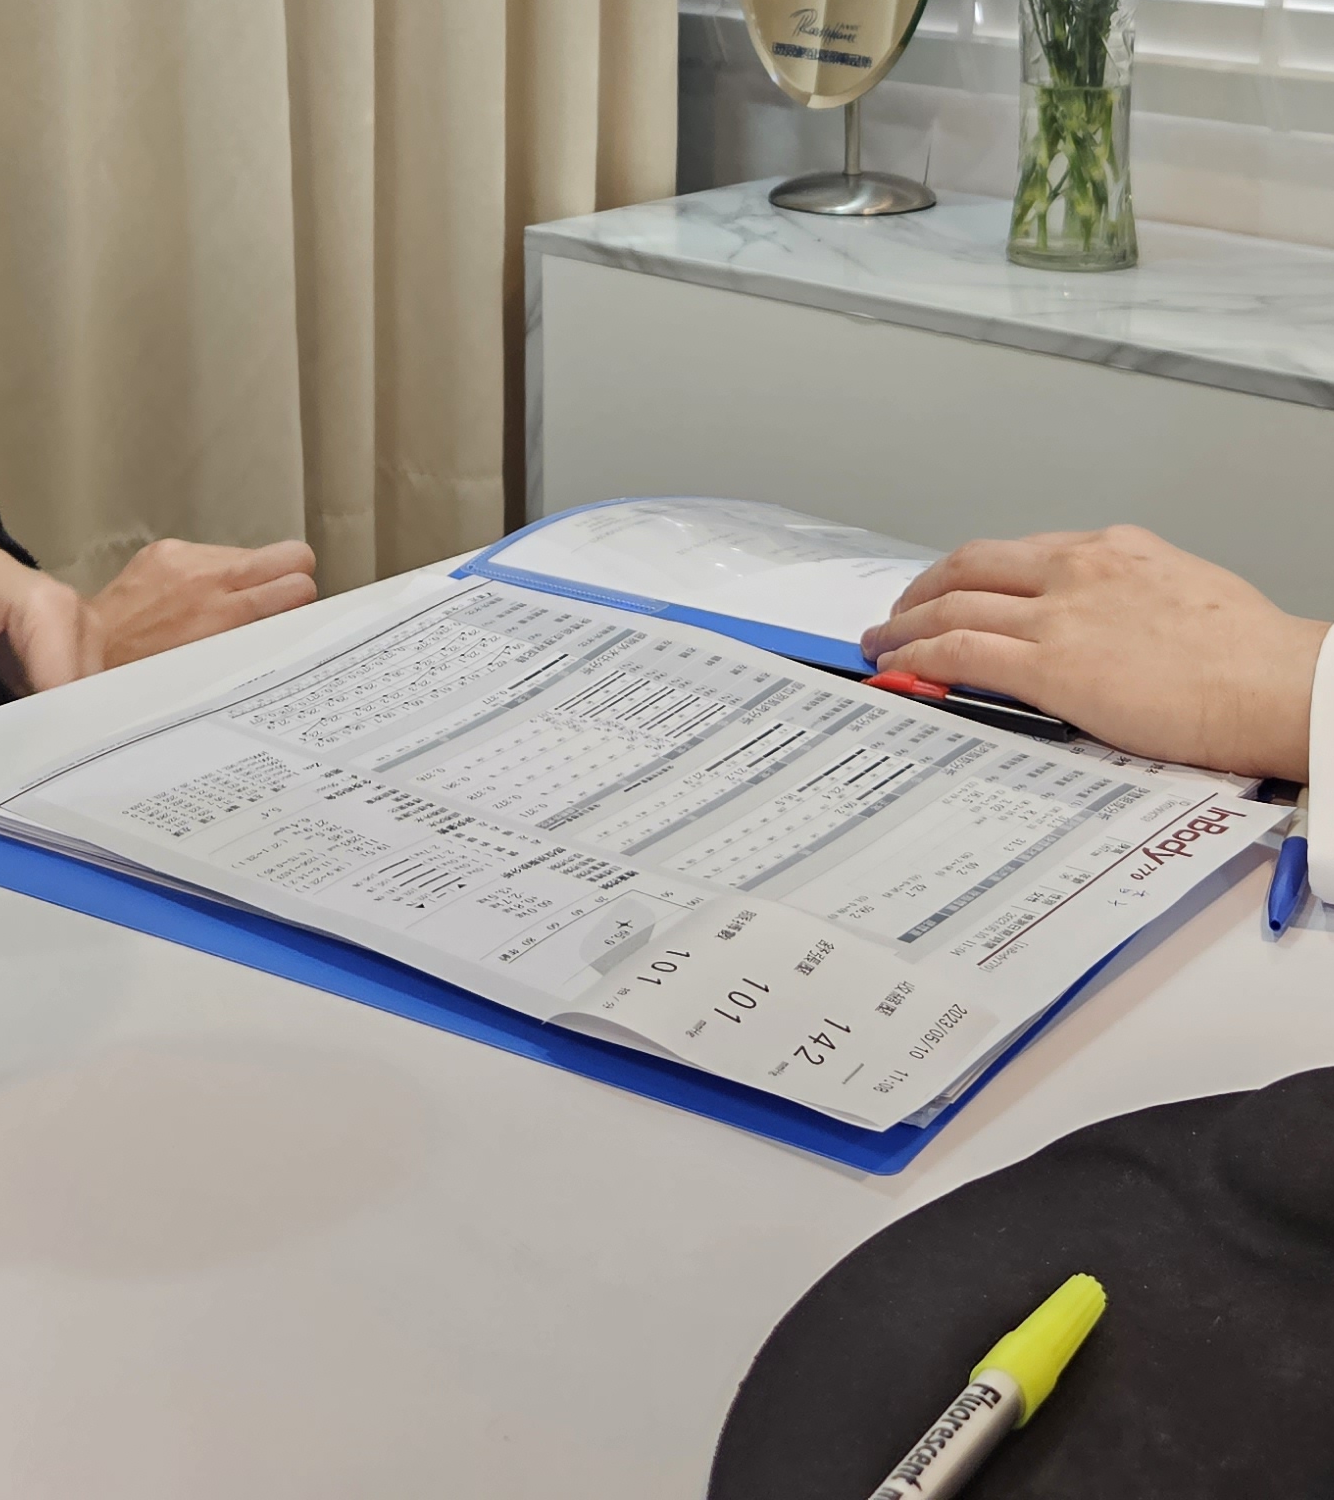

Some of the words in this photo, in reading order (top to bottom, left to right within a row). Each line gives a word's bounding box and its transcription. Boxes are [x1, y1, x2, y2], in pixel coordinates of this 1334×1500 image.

[1142, 806, 1247, 865] InBody
[1130, 863, 1157, 880] 770
[637, 951, 690, 985] 101
[794, 939, 835, 976] 舒張壓
[714, 978, 769, 1023] 101
[875, 981, 914, 1017] 收縮壓
[793, 1018, 851, 1065] 142
[909, 1004, 968, 1059] 2023/05/10
[891, 1382, 1003, 1492] Fluorescent
